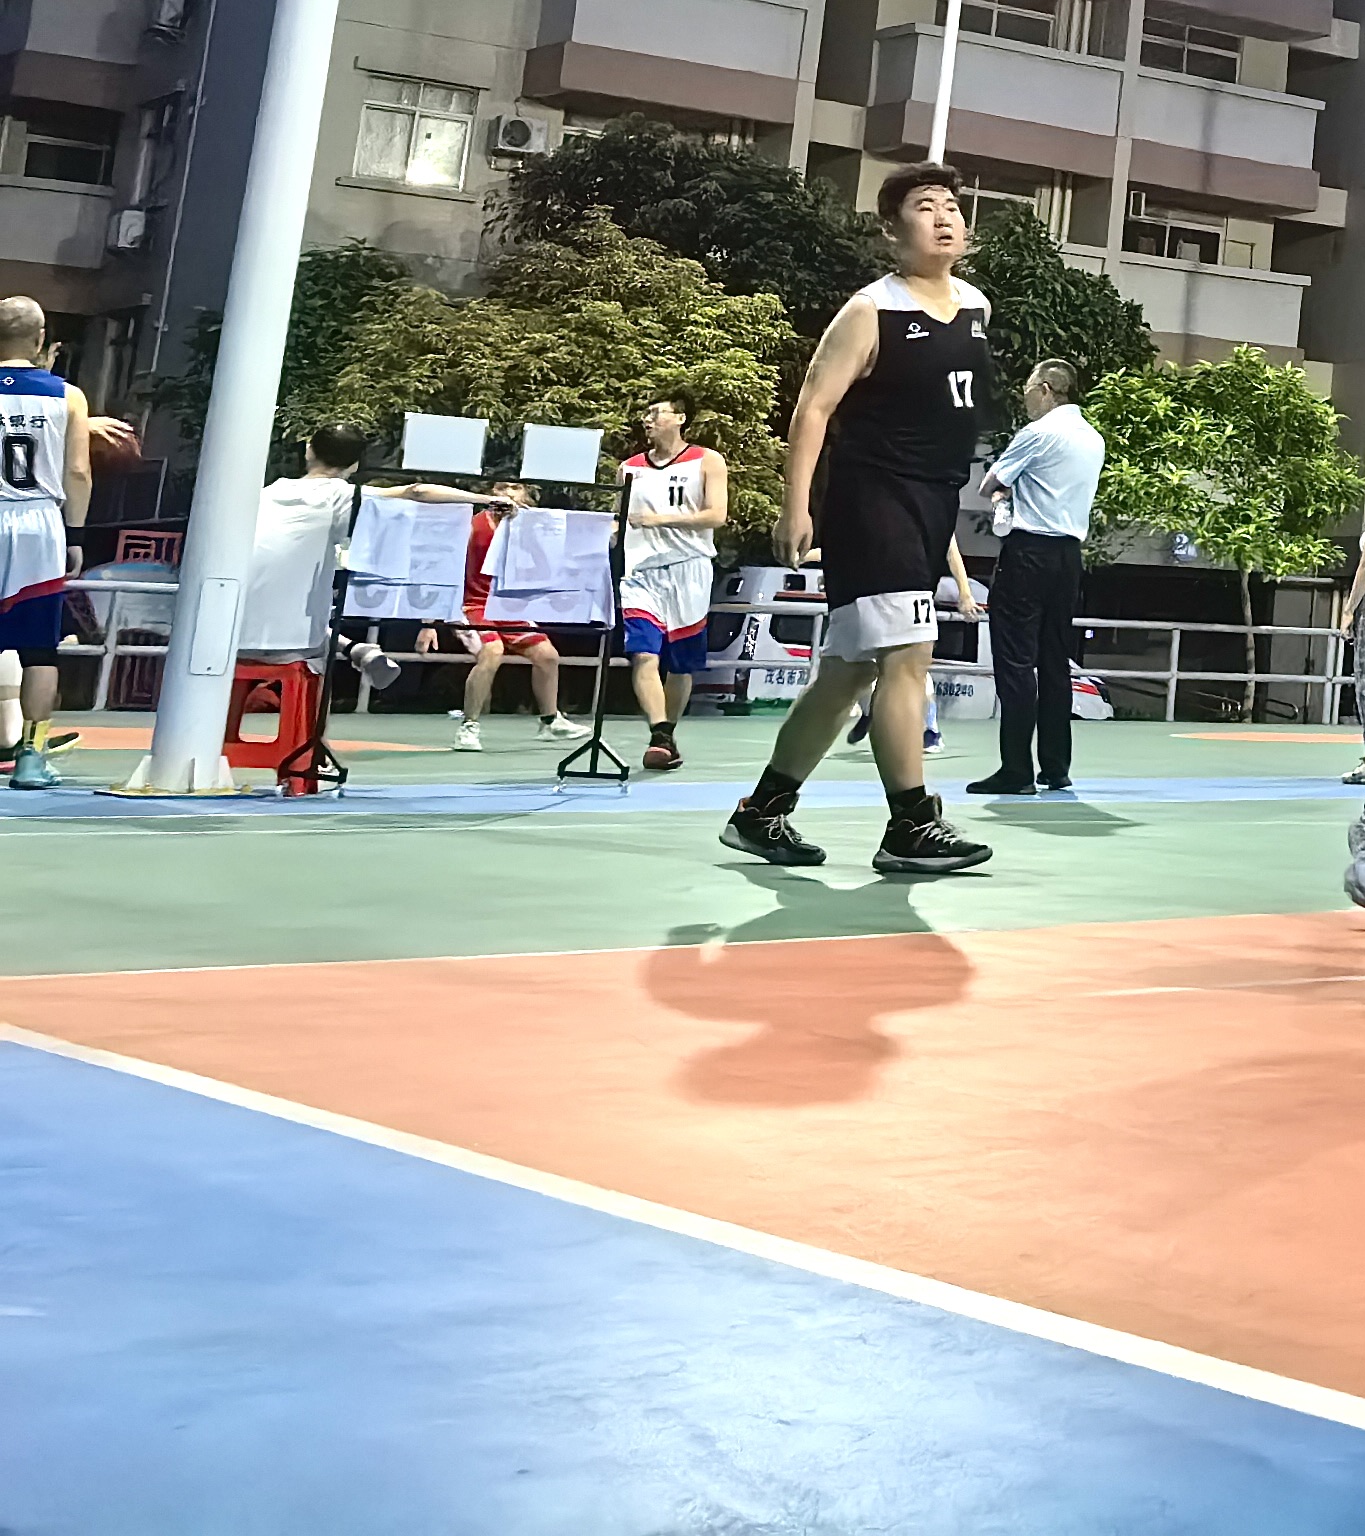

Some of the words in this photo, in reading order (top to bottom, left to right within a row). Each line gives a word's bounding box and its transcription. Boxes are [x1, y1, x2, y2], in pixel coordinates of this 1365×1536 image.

[947, 370, 975, 408] 17
[4, 434, 37, 489] 0
[669, 486, 684, 507] 11
[913, 598, 931, 624] 17
